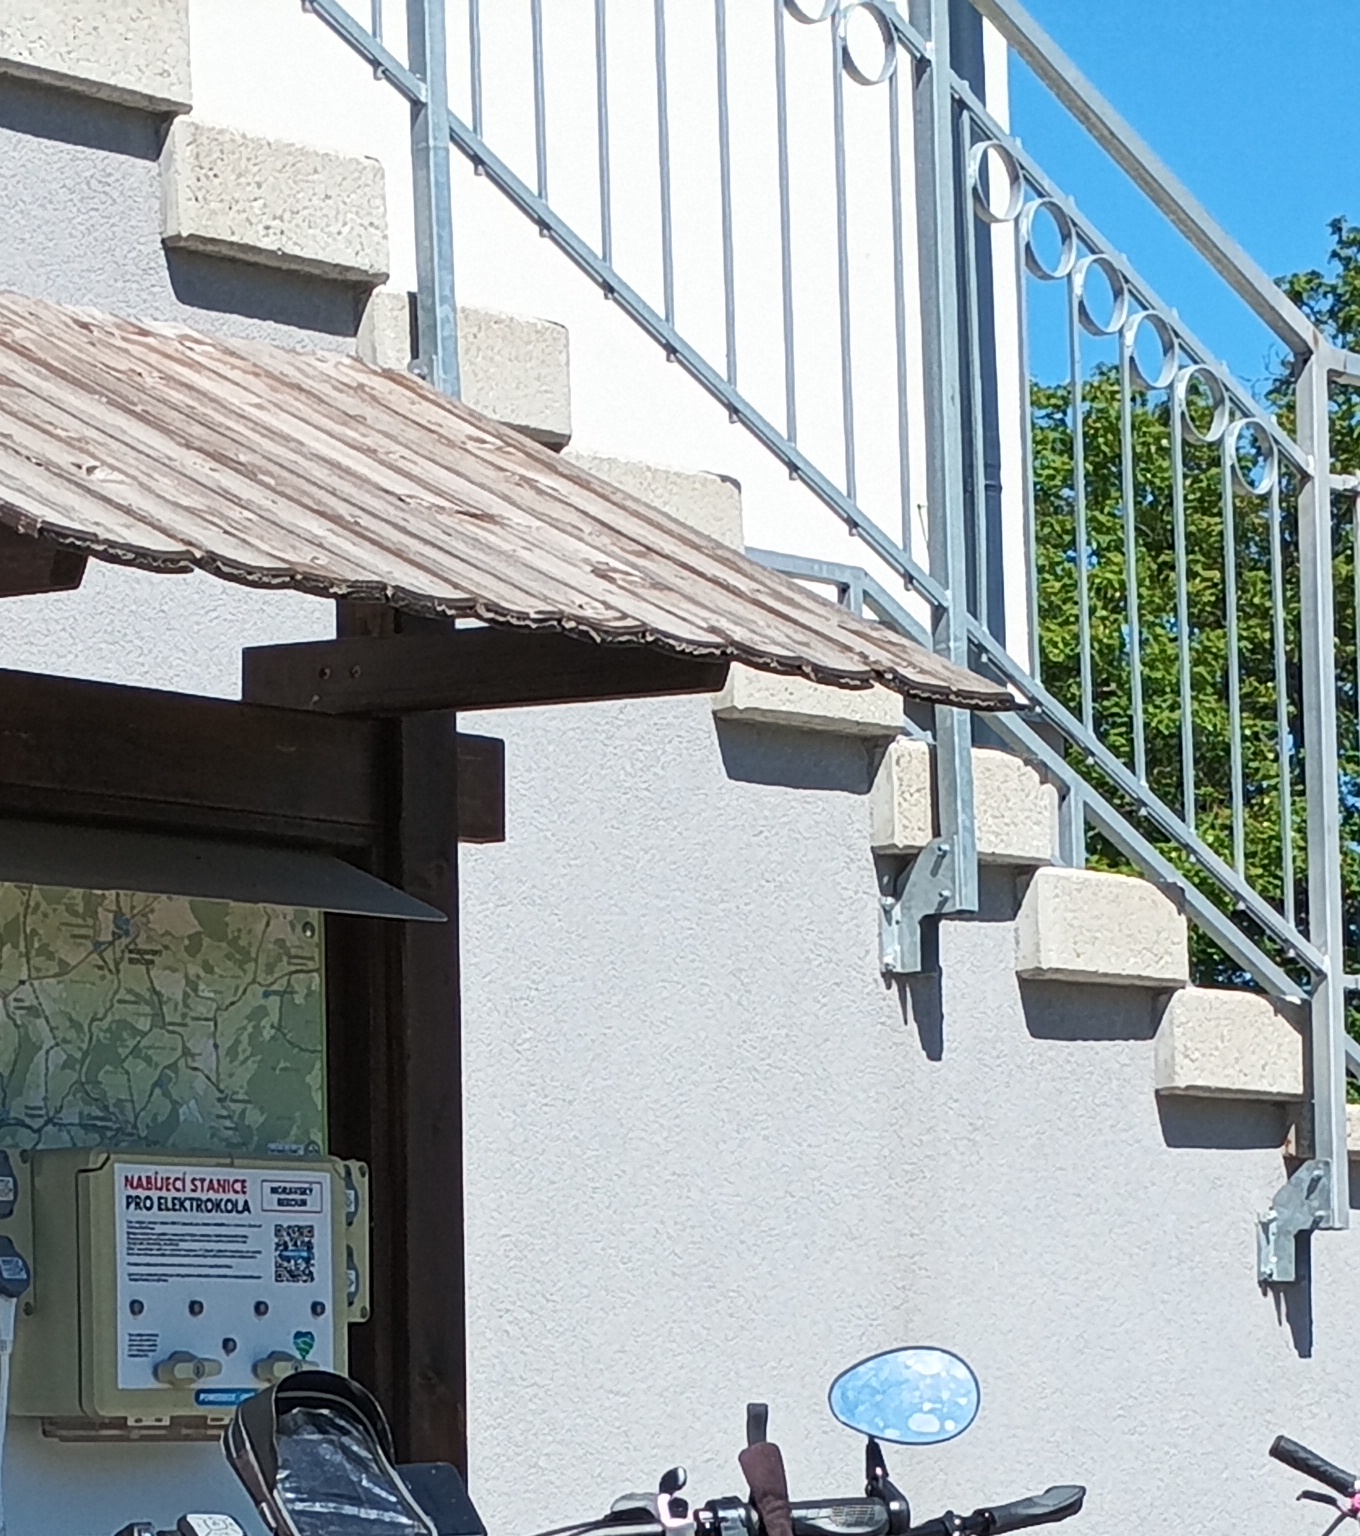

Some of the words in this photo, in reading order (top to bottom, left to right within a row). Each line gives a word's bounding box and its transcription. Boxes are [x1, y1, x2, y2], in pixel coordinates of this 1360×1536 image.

[124, 1171, 187, 1194] NABÍJECÍ
[190, 1176, 248, 1195] STANICE
[125, 1195, 154, 1212] PRO
[157, 1196, 252, 1215] ELEKTROKOLA
